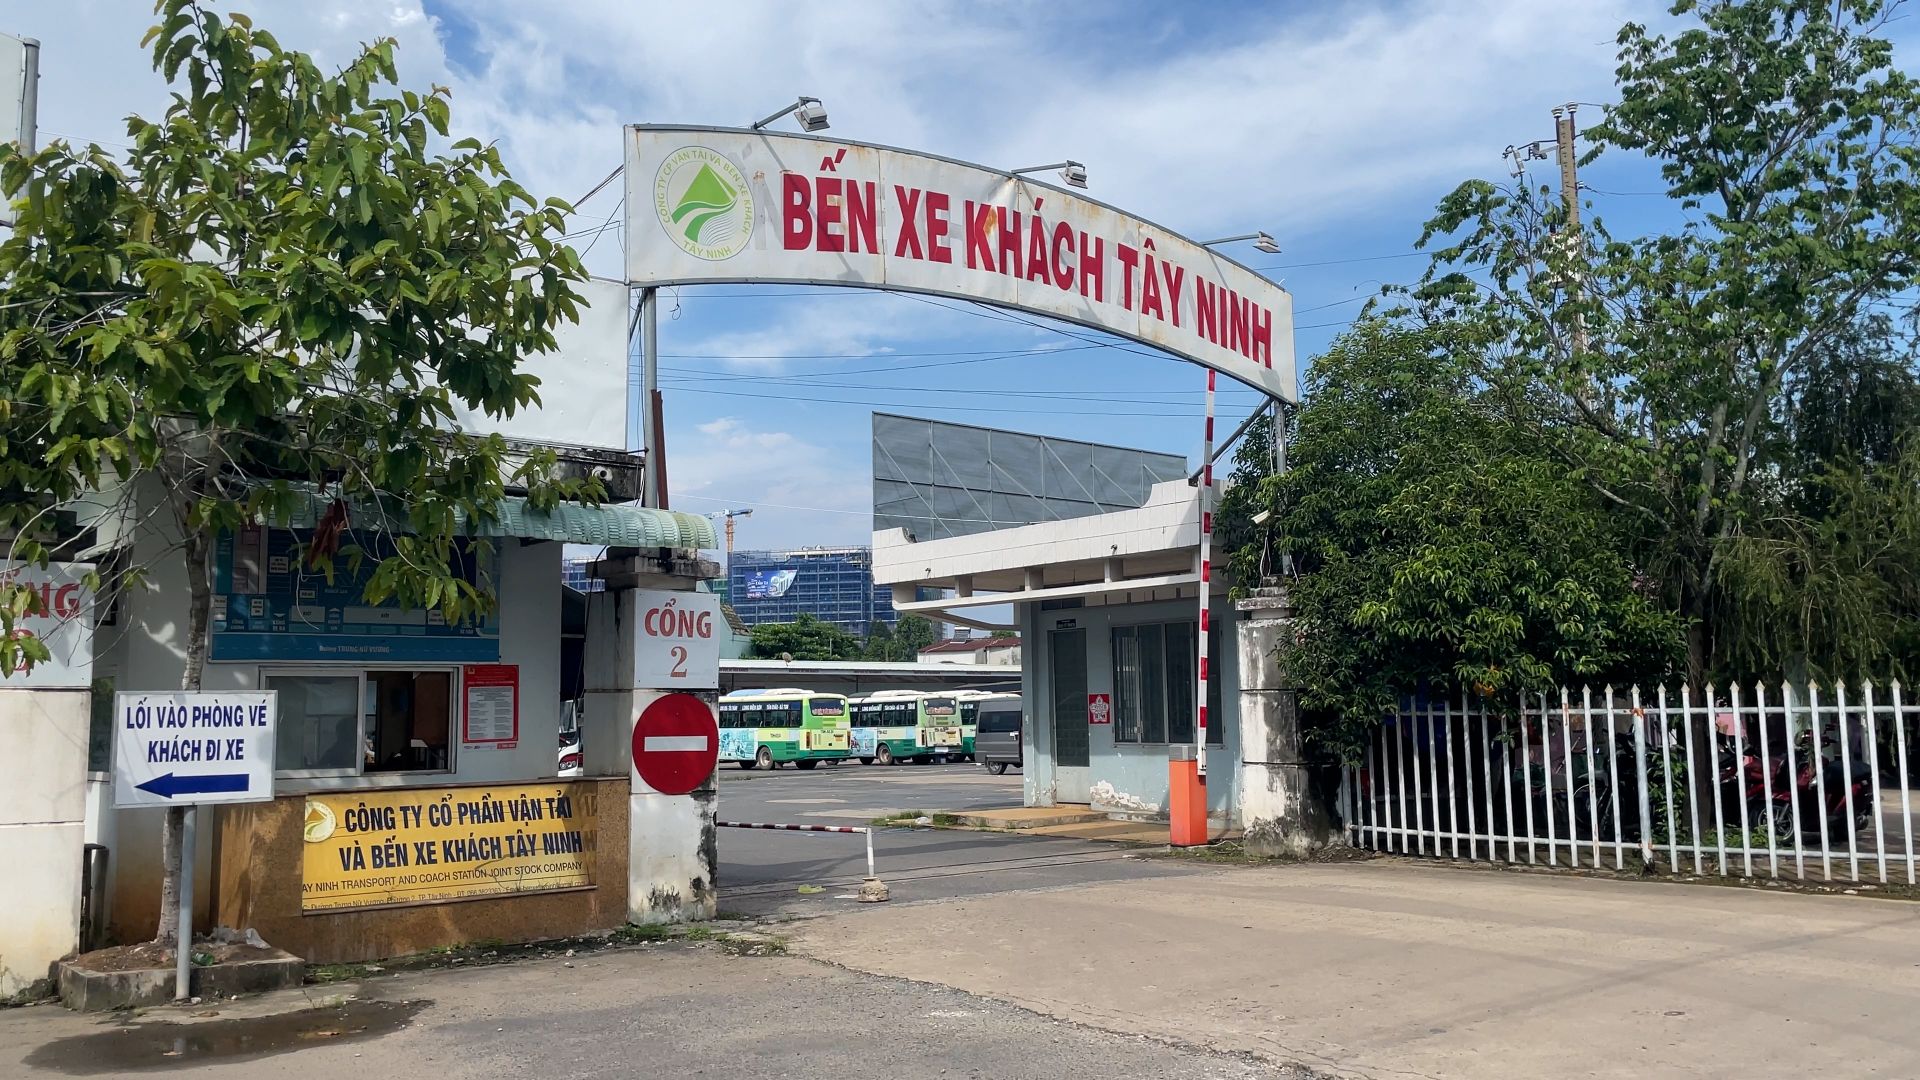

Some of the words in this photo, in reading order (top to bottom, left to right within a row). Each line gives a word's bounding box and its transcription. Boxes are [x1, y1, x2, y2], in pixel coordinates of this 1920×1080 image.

[706, 245, 732, 259] NINH
[784, 149, 878, 255] BẾN
[895, 186, 952, 263] XE
[966, 198, 1104, 303] KHÁCH
[1117, 239, 1184, 327] TÂY
[1197, 276, 1272, 369] NINH
[645, 598, 711, 638] CỔNG
[670, 646, 688, 678] 2
[126, 699, 151, 729] LỐI
[156, 700, 188, 729] VÀO
[192, 700, 244, 728] PHÒNG
[248, 699, 267, 727] VÉ
[147, 735, 201, 763] KHÁCH
[206, 739, 221, 762] ĐI
[225, 738, 244, 761] XE
[345, 802, 396, 832] CÔNG
[400, 805, 422, 828] TY
[428, 794, 453, 827] CỔ
[457, 793, 505, 825] PHẦN
[508, 794, 543, 826] VẬN
[545, 790, 573, 819] TẢI
[338, 840, 366, 871] VÀ
[371, 835, 409, 869] BẾN
[414, 841, 438, 866] XE
[442, 832, 502, 863] KHÁCH
[505, 829, 537, 858] TÂY
[543, 831, 583, 855] NINH
[302, 884, 313, 893] AY
[315, 881, 339, 892] NINH
[341, 876, 396, 890] TRANSPORT
[398, 875, 418, 885] AND
[419, 872, 451, 883] COACH
[450, 867, 487, 880] STATION
[488, 866, 512, 878] JOINT
[514, 864, 542, 875] STOCK
[543, 861, 583, 873] COMPANY
